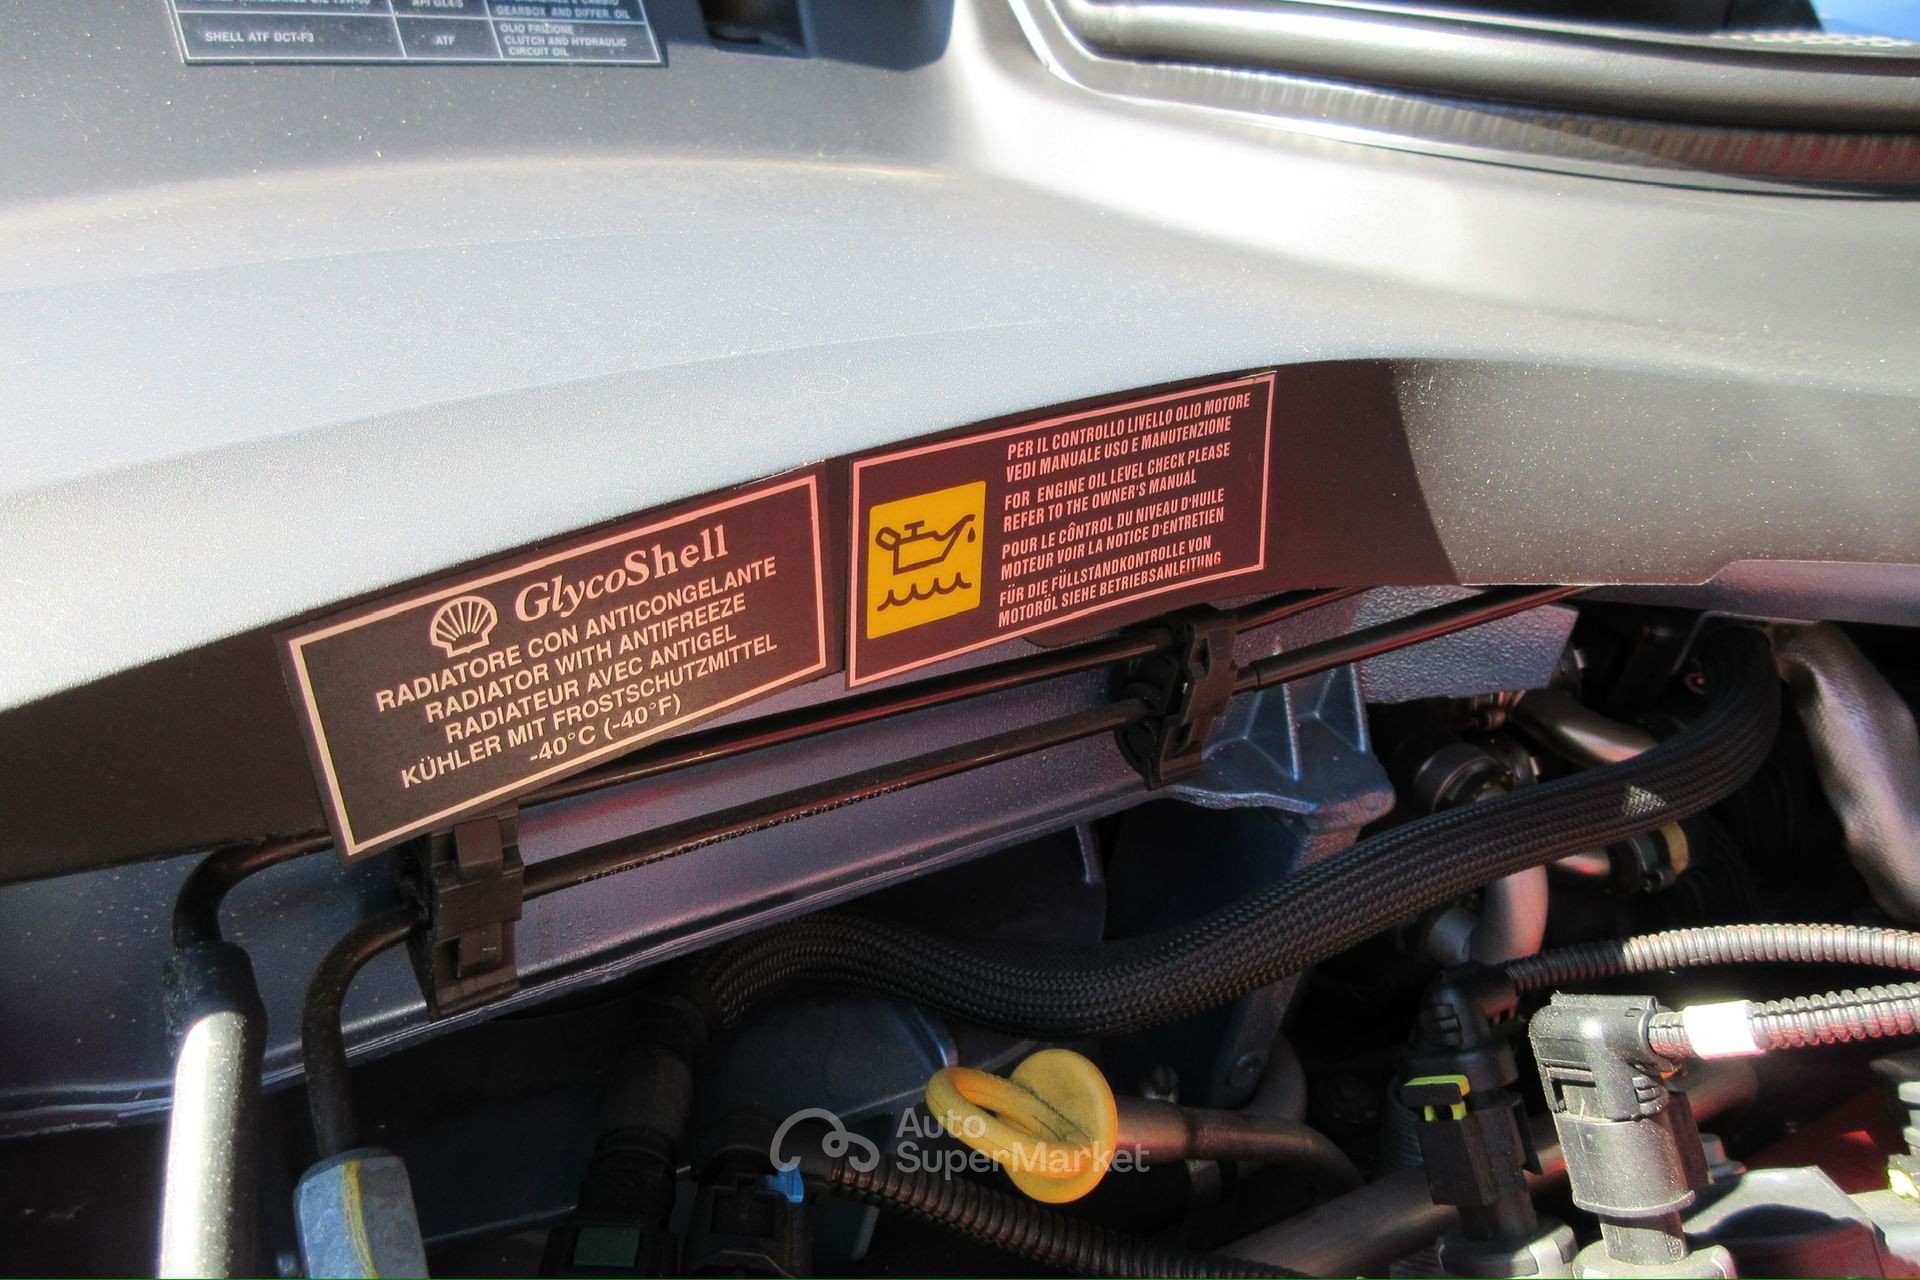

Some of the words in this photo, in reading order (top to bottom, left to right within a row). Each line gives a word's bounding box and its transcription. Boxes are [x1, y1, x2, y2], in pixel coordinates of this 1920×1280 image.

[205, 32, 245, 42] SHELL
[248, 32, 271, 42] ATF
[274, 32, 315, 43] DCT-F3
[434, 35, 456, 46] ATF
[495, 5, 547, 17] GEARBOX
[551, 7, 573, 17] AND
[614, 9, 631, 19] OIL
[500, 23, 526, 33] OLIO
[528, 24, 575, 35] FRIZIONE
[504, 35, 545, 45] CLUTCH
[547, 36, 569, 46] AND
[571, 36, 628, 47] HYDRAULIC
[508, 46, 549, 56] CIRCUIT
[552, 47, 570, 57] OIL
[1006, 461, 1036, 482] VEDI
[1040, 444, 1101, 475] MANUALE
[1104, 441, 1129, 459] USO
[1131, 437, 1139, 453] E
[1141, 416, 1232, 450] MANUTENZIONE
[1007, 440, 1033, 460] PER
[1037, 437, 1049, 453] IL
[1052, 419, 1125, 450] CONTROLLO
[1127, 408, 1173, 434] LIVELLO
[1175, 402, 1201, 422] OLIO
[1204, 392, 1251, 416] MOTORE
[1003, 508, 1044, 533] REFER
[1048, 504, 1063, 521] TO
[1066, 497, 1088, 515] THE
[1092, 482, 1146, 509] OWNER'S
[1149, 468, 1197, 494] MANUAL
[1004, 490, 1030, 511] FOR
[1037, 477, 1085, 502] ENGINE
[1088, 472, 1107, 490] OIL
[1110, 462, 1144, 484] LEVEL
[1147, 454, 1185, 475] CHECK
[1187, 442, 1231, 465] PLEASE
[1001, 552, 1054, 581] MOTEUR
[1057, 544, 1085, 564] VOIR
[1088, 539, 1103, 555] LA
[1106, 526, 1149, 550] NOTICE
[1151, 507, 1225, 538] D'ENTRETIEN
[1002, 537, 1038, 559] POUR
[1041, 532, 1055, 549] LE
[1058, 516, 1114, 546] CÔNTROL
[1117, 510, 1133, 527] DU
[1135, 499, 1178, 524] NIVEAU
[1181, 488, 1225, 512] D'HUILE
[515, 524, 729, 622] GlycoShell
[998, 593, 1058, 627] MOTORÖL
[1061, 584, 1097, 607] SIEHE
[1099, 551, 1222, 596] BETRIEBSANLEITUNG
[999, 582, 1025, 606] FÜR
[1028, 579, 1048, 598] DIE
[1051, 541, 1186, 593] FÜLLSTANDKONTROLLE
[1188, 535, 1212, 553] VON
[376, 645, 523, 712] RADIATORE
[528, 624, 579, 658] CON
[585, 556, 777, 640] ANTICONGELANTE
[425, 663, 549, 723] RADIATOR
[555, 640, 613, 676] WITH
[619, 593, 746, 655] ANTIFREEZE
[401, 735, 502, 789] KÜHLER
[507, 717, 546, 748] MIT
[552, 633, 778, 731] FROSTSCHUTZMITTEL
[445, 679, 580, 743] RADIATEUR
[587, 656, 643, 692] AVEC
[650, 624, 737, 669] ANTIGEL
[529, 725, 596, 762] -40°C
